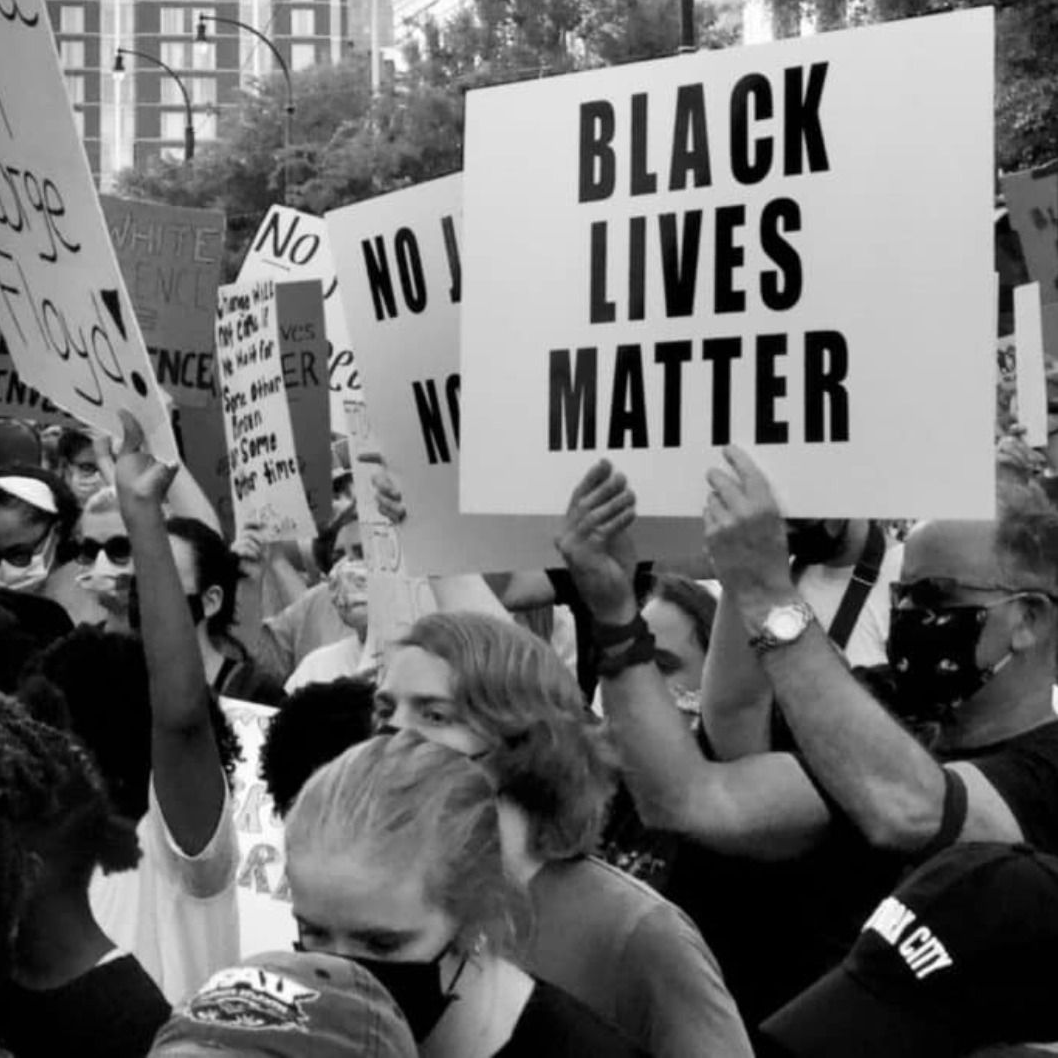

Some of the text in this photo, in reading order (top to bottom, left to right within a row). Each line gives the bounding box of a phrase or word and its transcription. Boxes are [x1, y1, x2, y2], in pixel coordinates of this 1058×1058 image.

[578, 62, 830, 203] BLACK
[362, 227, 427, 321] NO
[590, 198, 802, 324] LIVES
[548, 330, 850, 452] MATTER
[898, 925, 954, 980] CITY
